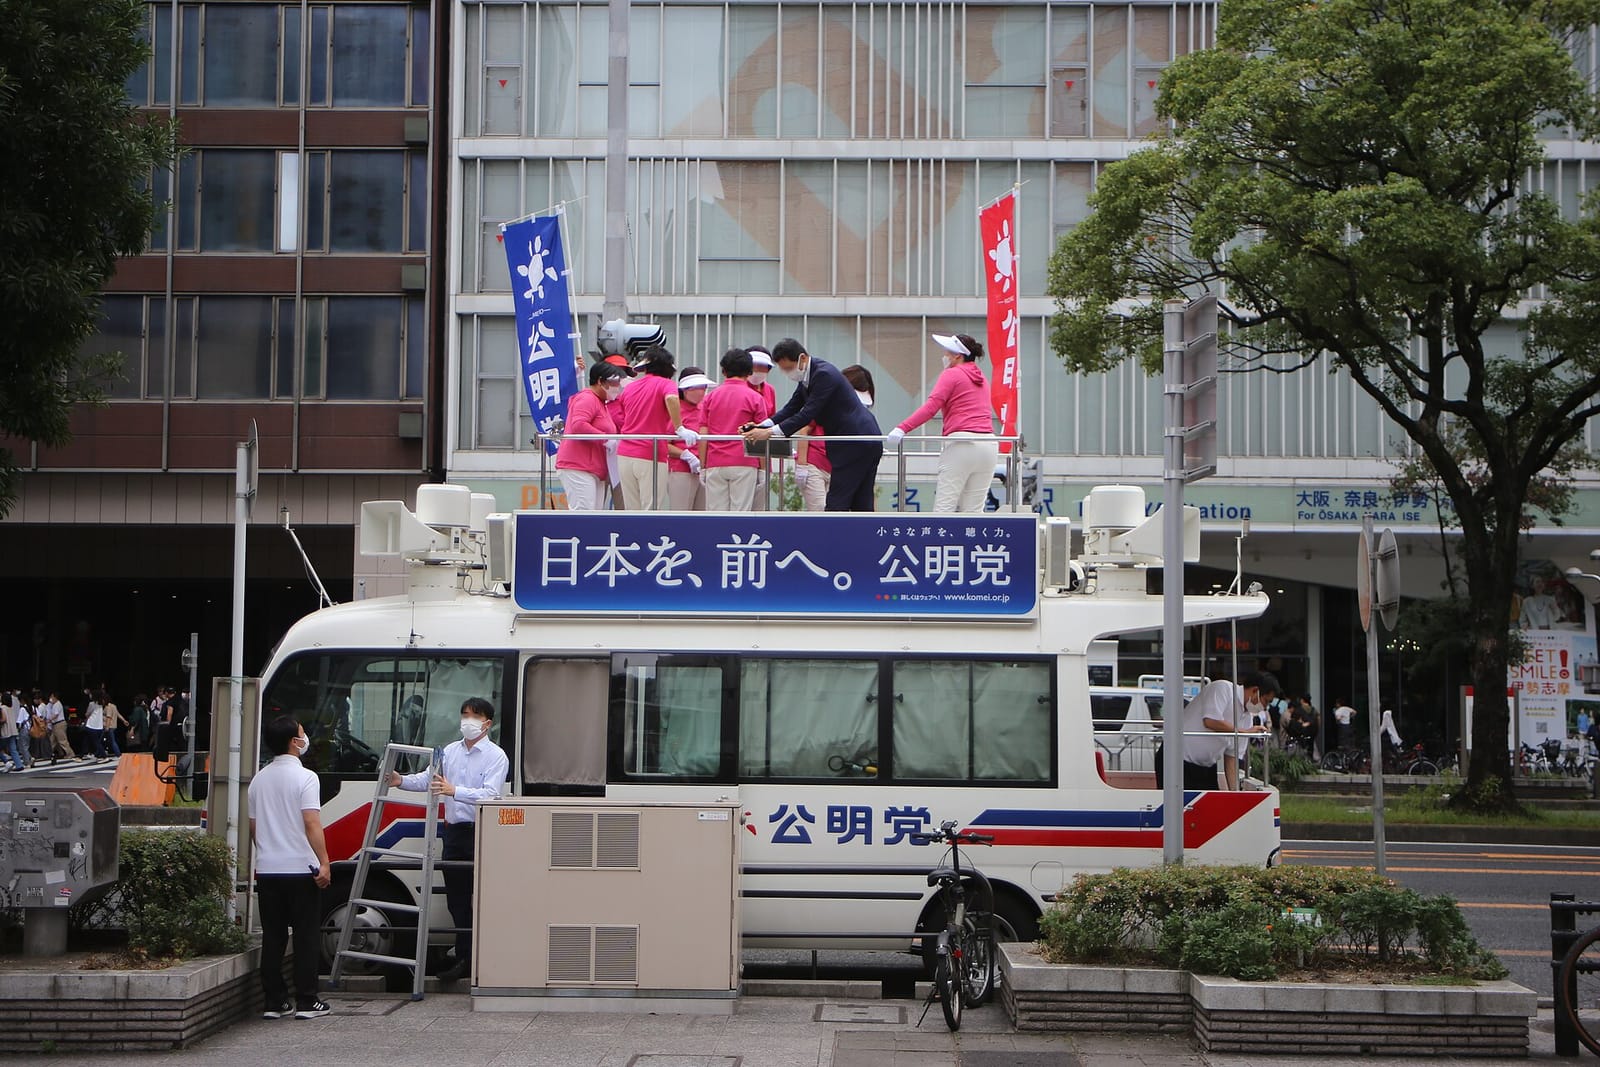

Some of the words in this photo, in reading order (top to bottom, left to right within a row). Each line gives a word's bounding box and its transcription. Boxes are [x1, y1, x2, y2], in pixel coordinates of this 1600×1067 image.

[1298, 511, 1314, 520] For
[1364, 511, 1396, 521] ARA
[1403, 512, 1420, 521] ISE
[541, 532, 853, 591] 日本を、前へ。
[878, 544, 1011, 586] 公明党
[944, 592, 1010, 604] www.komei.or.jp
[768, 804, 931, 846] 公明党
